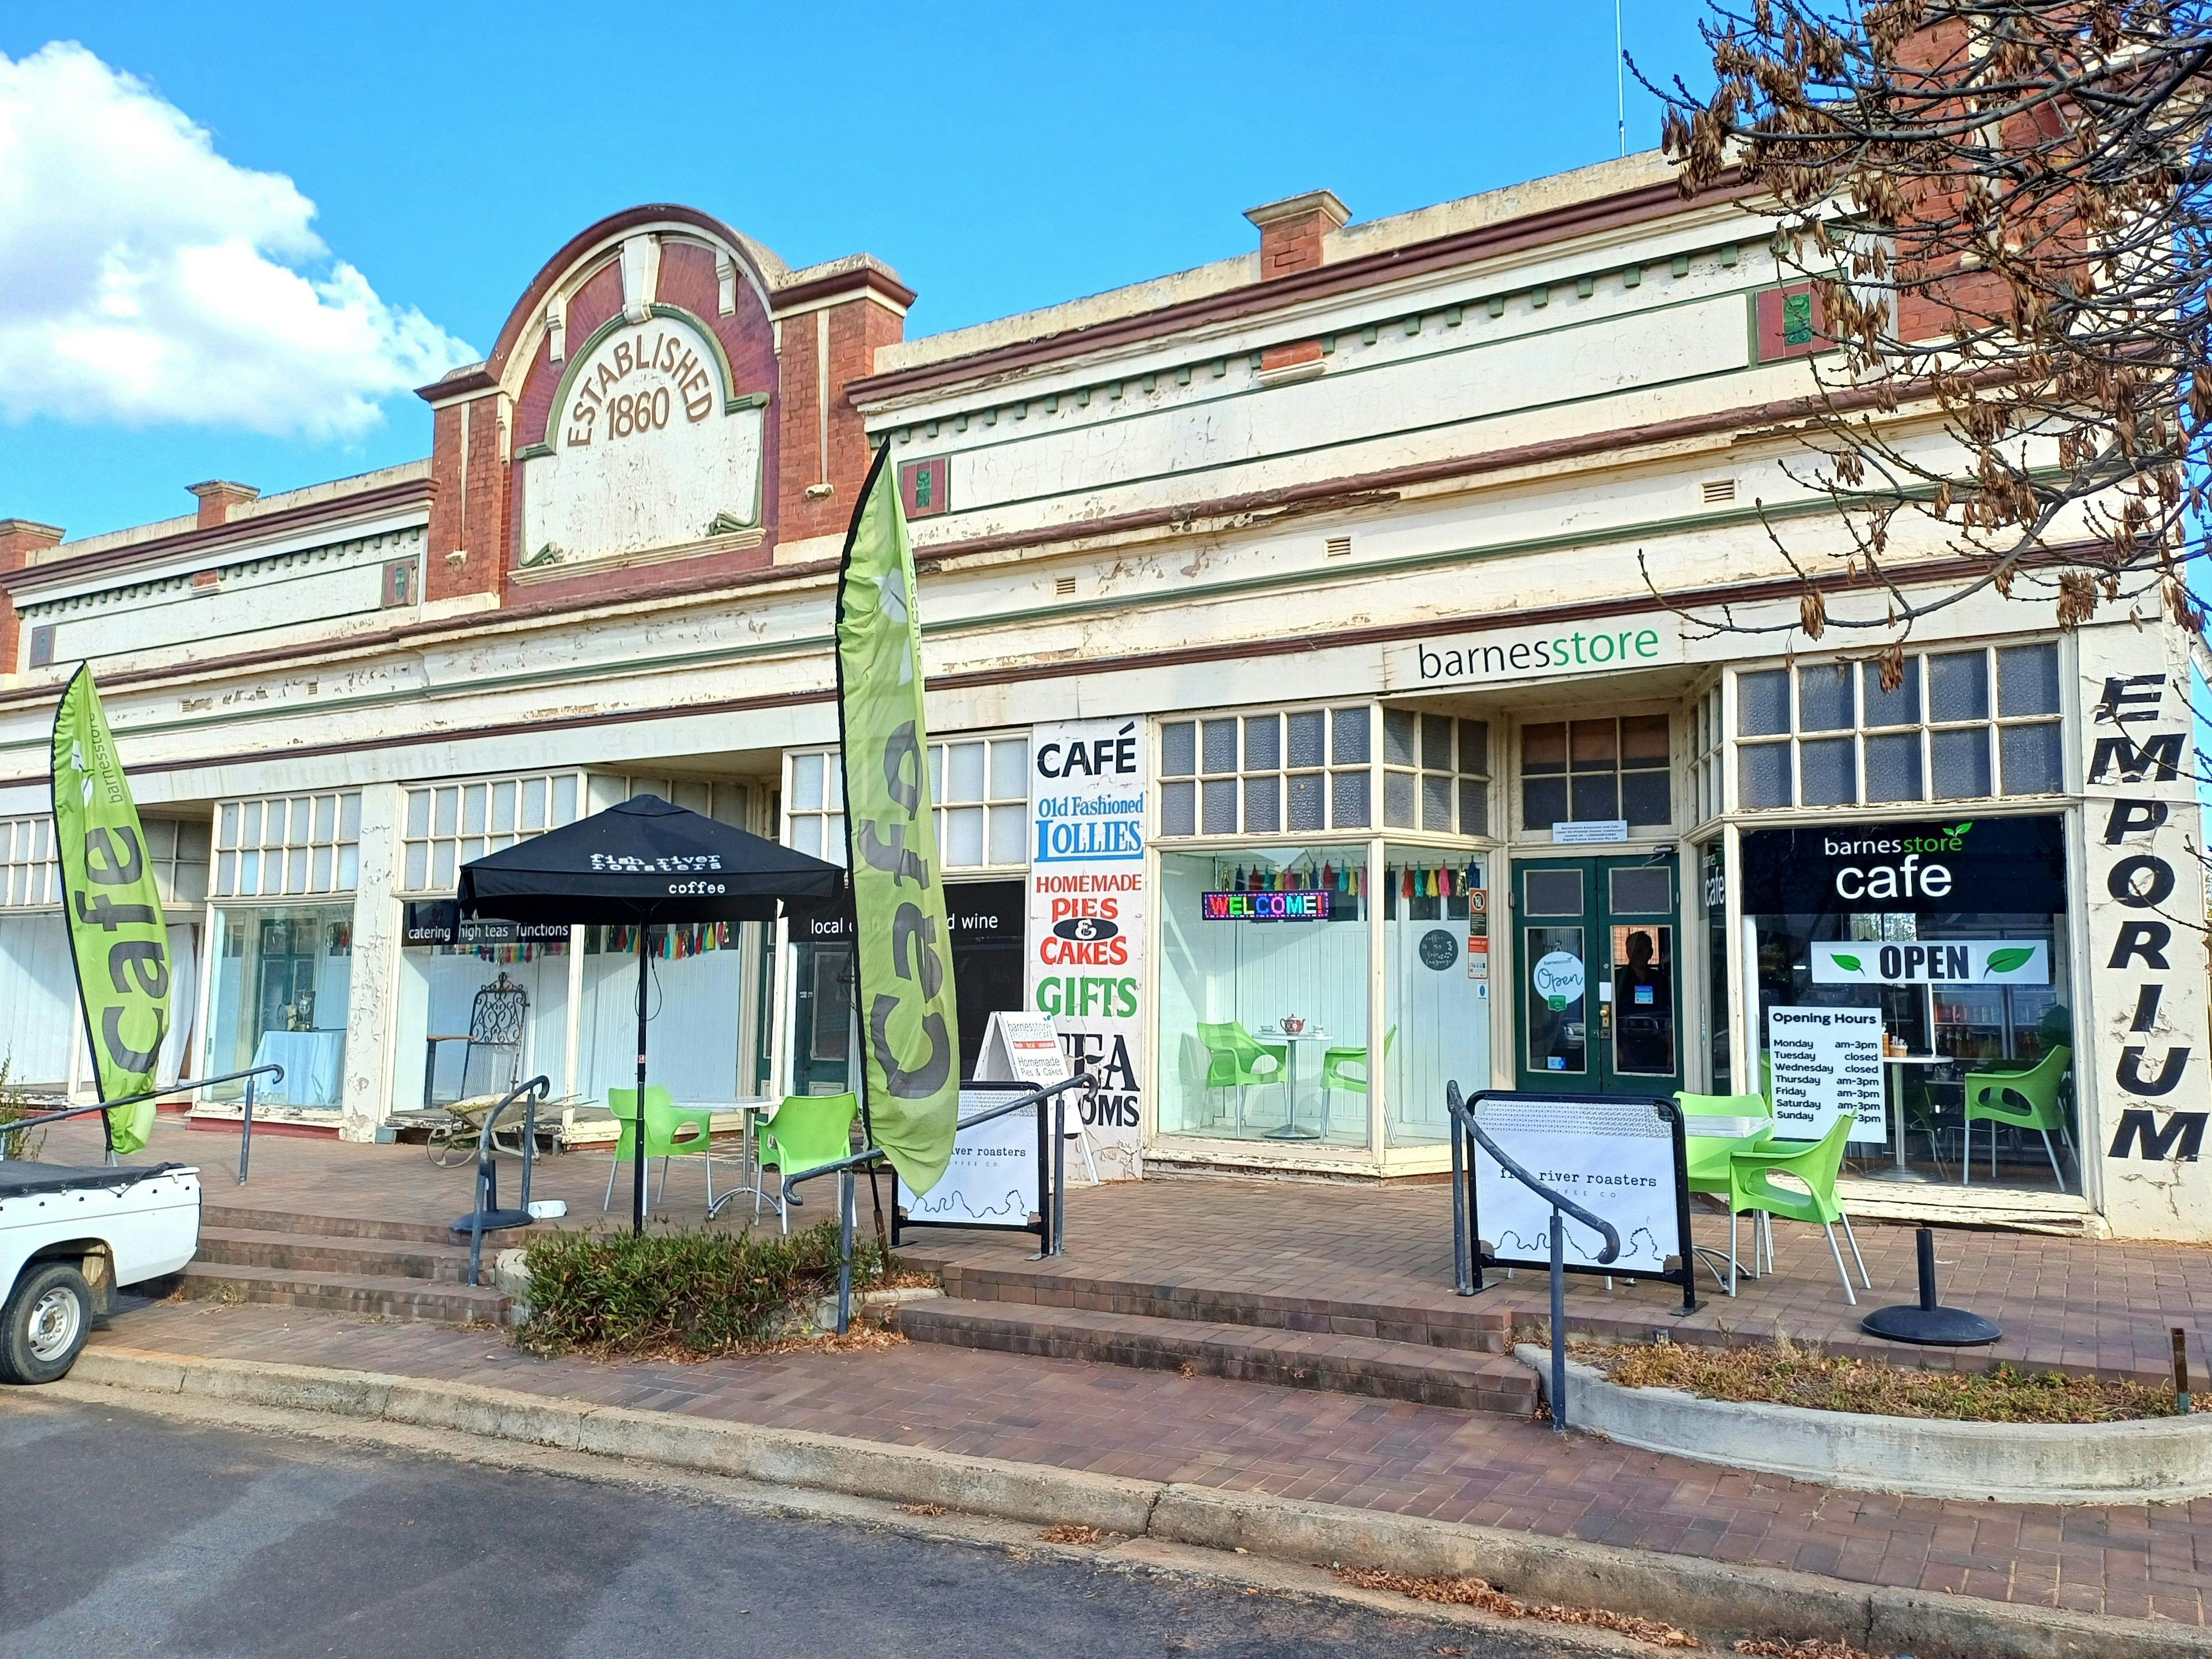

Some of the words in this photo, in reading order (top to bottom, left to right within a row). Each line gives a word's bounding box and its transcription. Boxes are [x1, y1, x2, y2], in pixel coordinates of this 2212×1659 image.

[568, 332, 712, 447] ESTABLISHED
[607, 387, 670, 440] 1860
[1418, 629, 1658, 679] barnesstore
[1037, 721, 1136, 778] CAFÉ
[1039, 796, 1068, 817] Old
[1071, 791, 1144, 816] Fashioned
[1034, 820, 1144, 862] LOLLIES
[1825, 837, 1962, 855] barnesstore
[590, 853, 645, 865] fish
[656, 855, 720, 865] river
[592, 863, 721, 872] roasters
[1036, 874, 1141, 893] HOMEMADE
[1837, 854, 1952, 899] cafe
[669, 881, 726, 894] coffee
[1705, 866, 1725, 907] cafe
[858, 719, 950, 1099] cafe
[1052, 898, 1118, 923] PIES
[1209, 894, 1322, 915] WELCOME!
[811, 917, 843, 934] local
[962, 913, 998, 929] wine
[2087, 674, 2209, 1162] EMPORIUM
[409, 926, 451, 941] catering
[458, 924, 481, 941] high
[486, 924, 508, 937] teas
[516, 923, 568, 937] functions
[1075, 919, 1097, 939] &
[77, 826, 168, 1074] cafe
[1040, 936, 1128, 965] CAKES
[1880, 945, 1969, 979] OPEN
[1538, 968, 1583, 992] Open
[1036, 977, 1137, 1018] GIFTS
[1007, 1020, 1051, 1032] barnesstore
[1773, 1013, 1831, 1025] Opening
[1835, 1013, 1876, 1024] Hours
[1773, 1040, 1813, 1049] Monday
[1835, 1041, 1877, 1050] am-3pm
[1018, 1057, 1060, 1067] Homemade
[1057, 1033, 1140, 1092] EA
[1774, 1051, 1815, 1061] Tuesday
[1844, 1053, 1878, 1061] closed
[1021, 1068, 1034, 1076] Pies
[1035, 1068, 1041, 1076] &
[1043, 1067, 1063, 1076] Cakes
[1775, 1063, 1834, 1074] Wednesday
[1845, 1065, 1879, 1073] closed
[1775, 1075, 1820, 1086] Thursday
[1776, 1087, 1806, 1097] Friday
[1837, 1090, 1880, 1099] am-3pm
[1078, 1094, 1140, 1127] OMS
[1777, 1099, 1821, 1110] Saturday
[1838, 1102, 1880, 1112] am-3pm
[1777, 1111, 1814, 1121] Sunday
[1854, 1114, 1881, 1124] -3pm
[977, 1147, 1026, 1156] roasters
[1539, 1170, 1580, 1182] river
[1587, 1174, 1657, 1187] roasters
